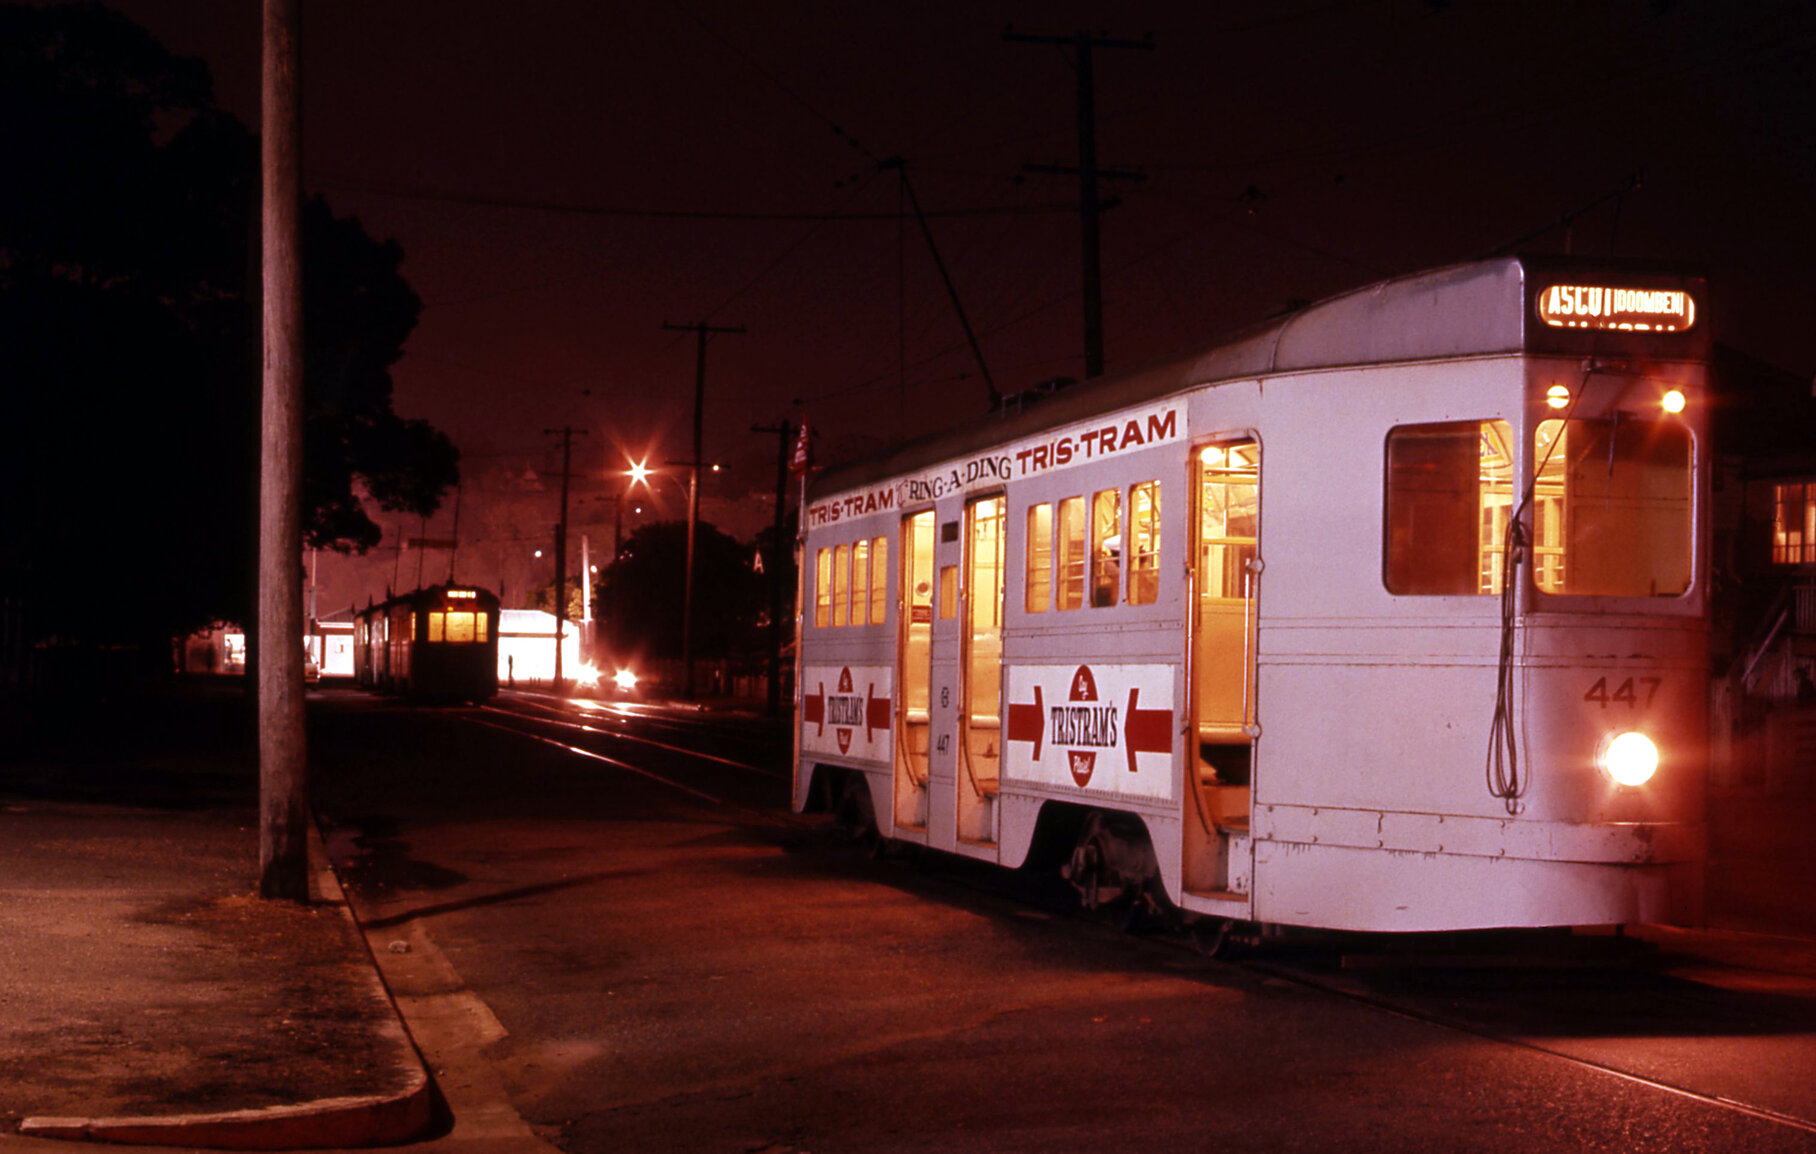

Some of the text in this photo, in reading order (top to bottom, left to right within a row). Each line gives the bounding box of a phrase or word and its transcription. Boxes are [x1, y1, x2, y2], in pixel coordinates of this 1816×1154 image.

[1584, 676, 1662, 709] 447
[1050, 701, 1118, 747] TRISTRAM'S
[937, 734, 950, 756] 447
